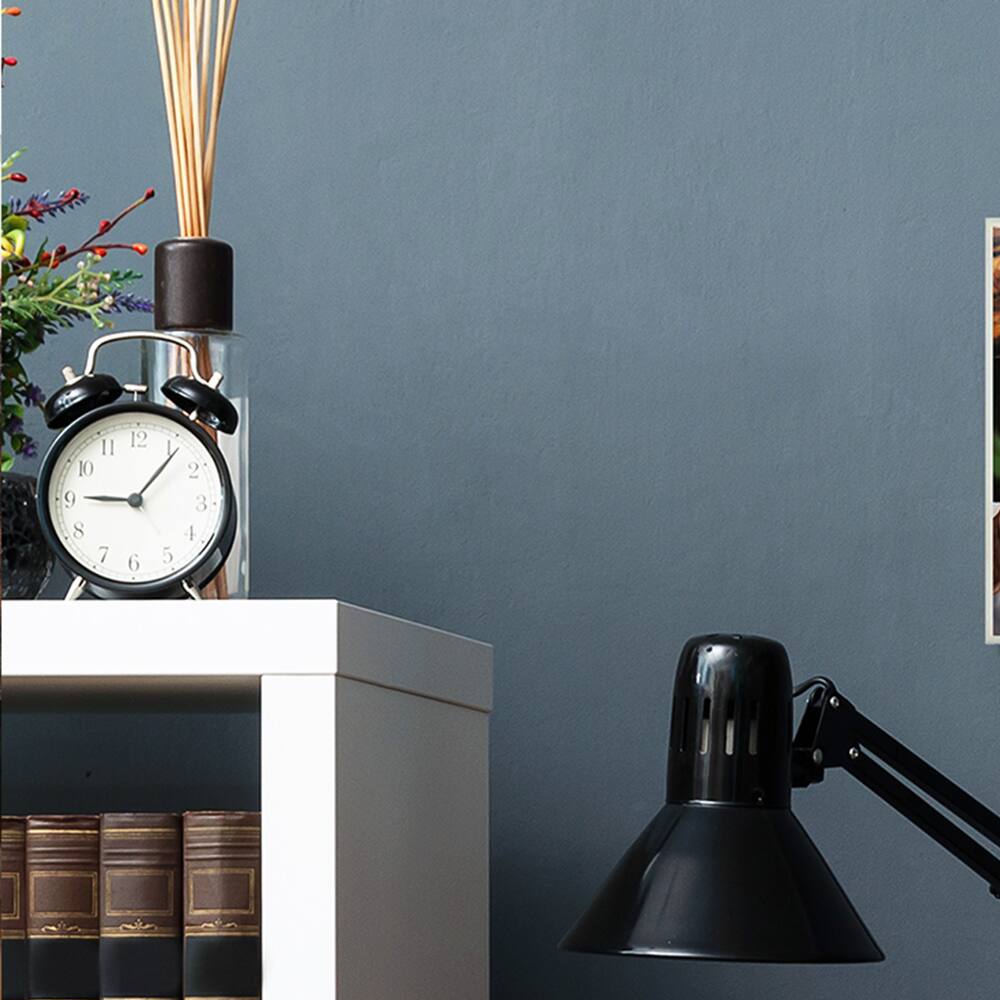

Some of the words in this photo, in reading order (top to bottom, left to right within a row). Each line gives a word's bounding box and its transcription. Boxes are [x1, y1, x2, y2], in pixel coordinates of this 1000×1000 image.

[101, 439, 115, 456] 11
[131, 431, 147, 448] 12
[78, 460, 94, 477] 10
[188, 462, 200, 479] 2
[64, 491, 76, 509] 9
[196, 495, 208, 512] 3
[73, 521, 84, 539] 8
[184, 525, 197, 541] 4
[99, 546, 109, 563] 7
[128, 554, 140, 572] 6
[162, 547, 173, 564] 5
